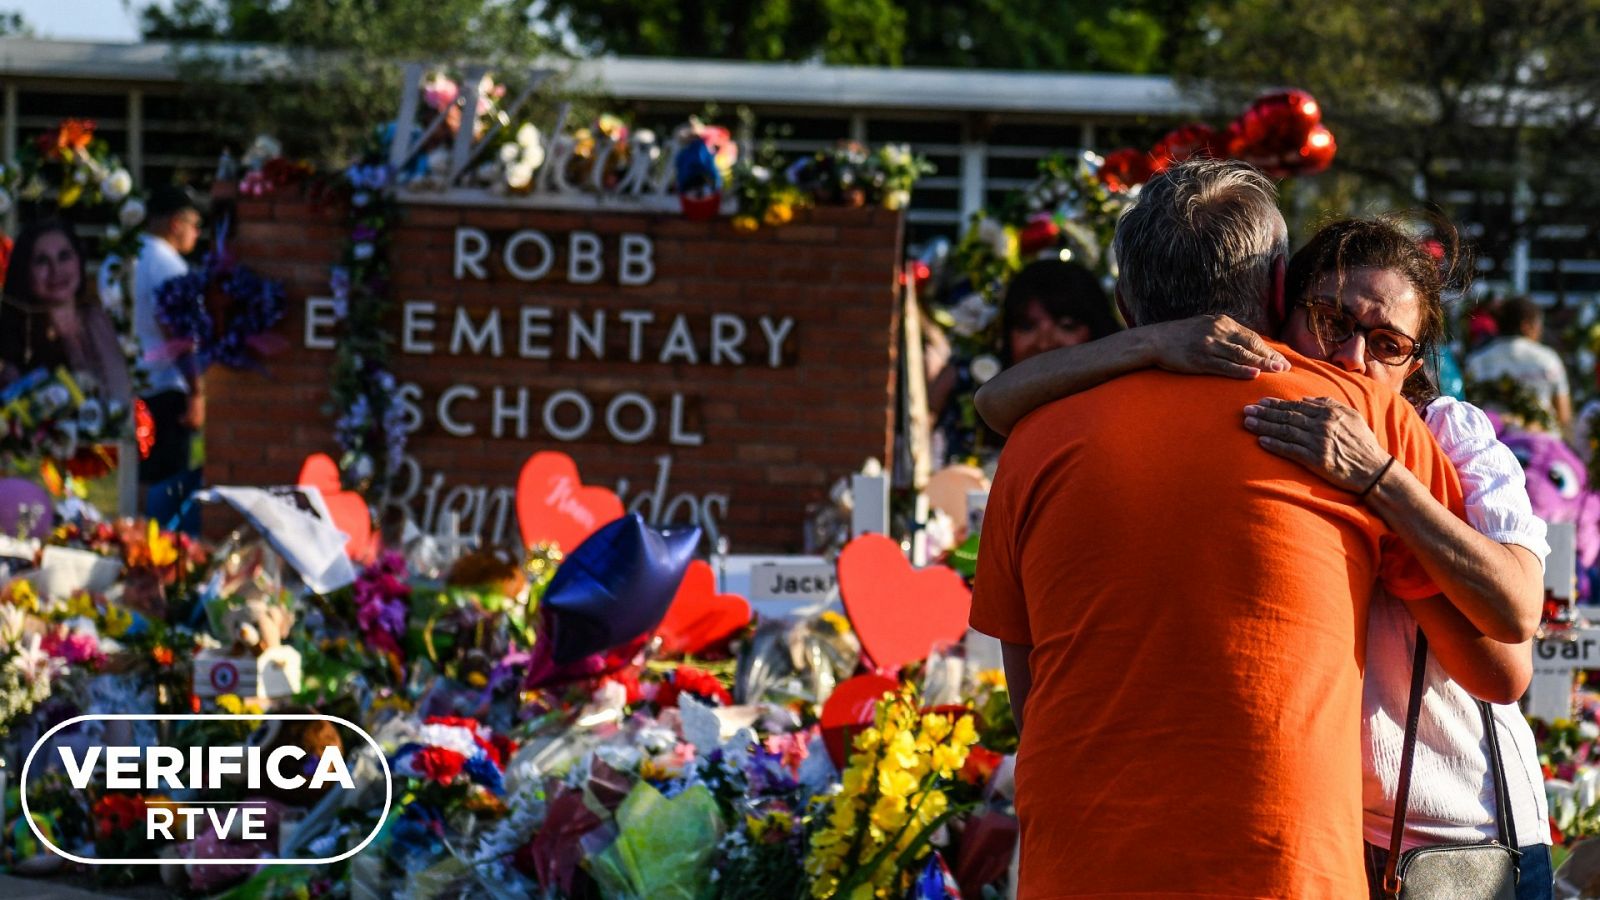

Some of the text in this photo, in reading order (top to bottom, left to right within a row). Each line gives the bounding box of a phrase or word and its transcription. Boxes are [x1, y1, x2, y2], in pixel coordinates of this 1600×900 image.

[453, 227, 655, 285] ROBB
[304, 299, 795, 368] EEMENTARY
[399, 383, 703, 446] SCHOOL
[1537, 639, 1600, 660] Gar
